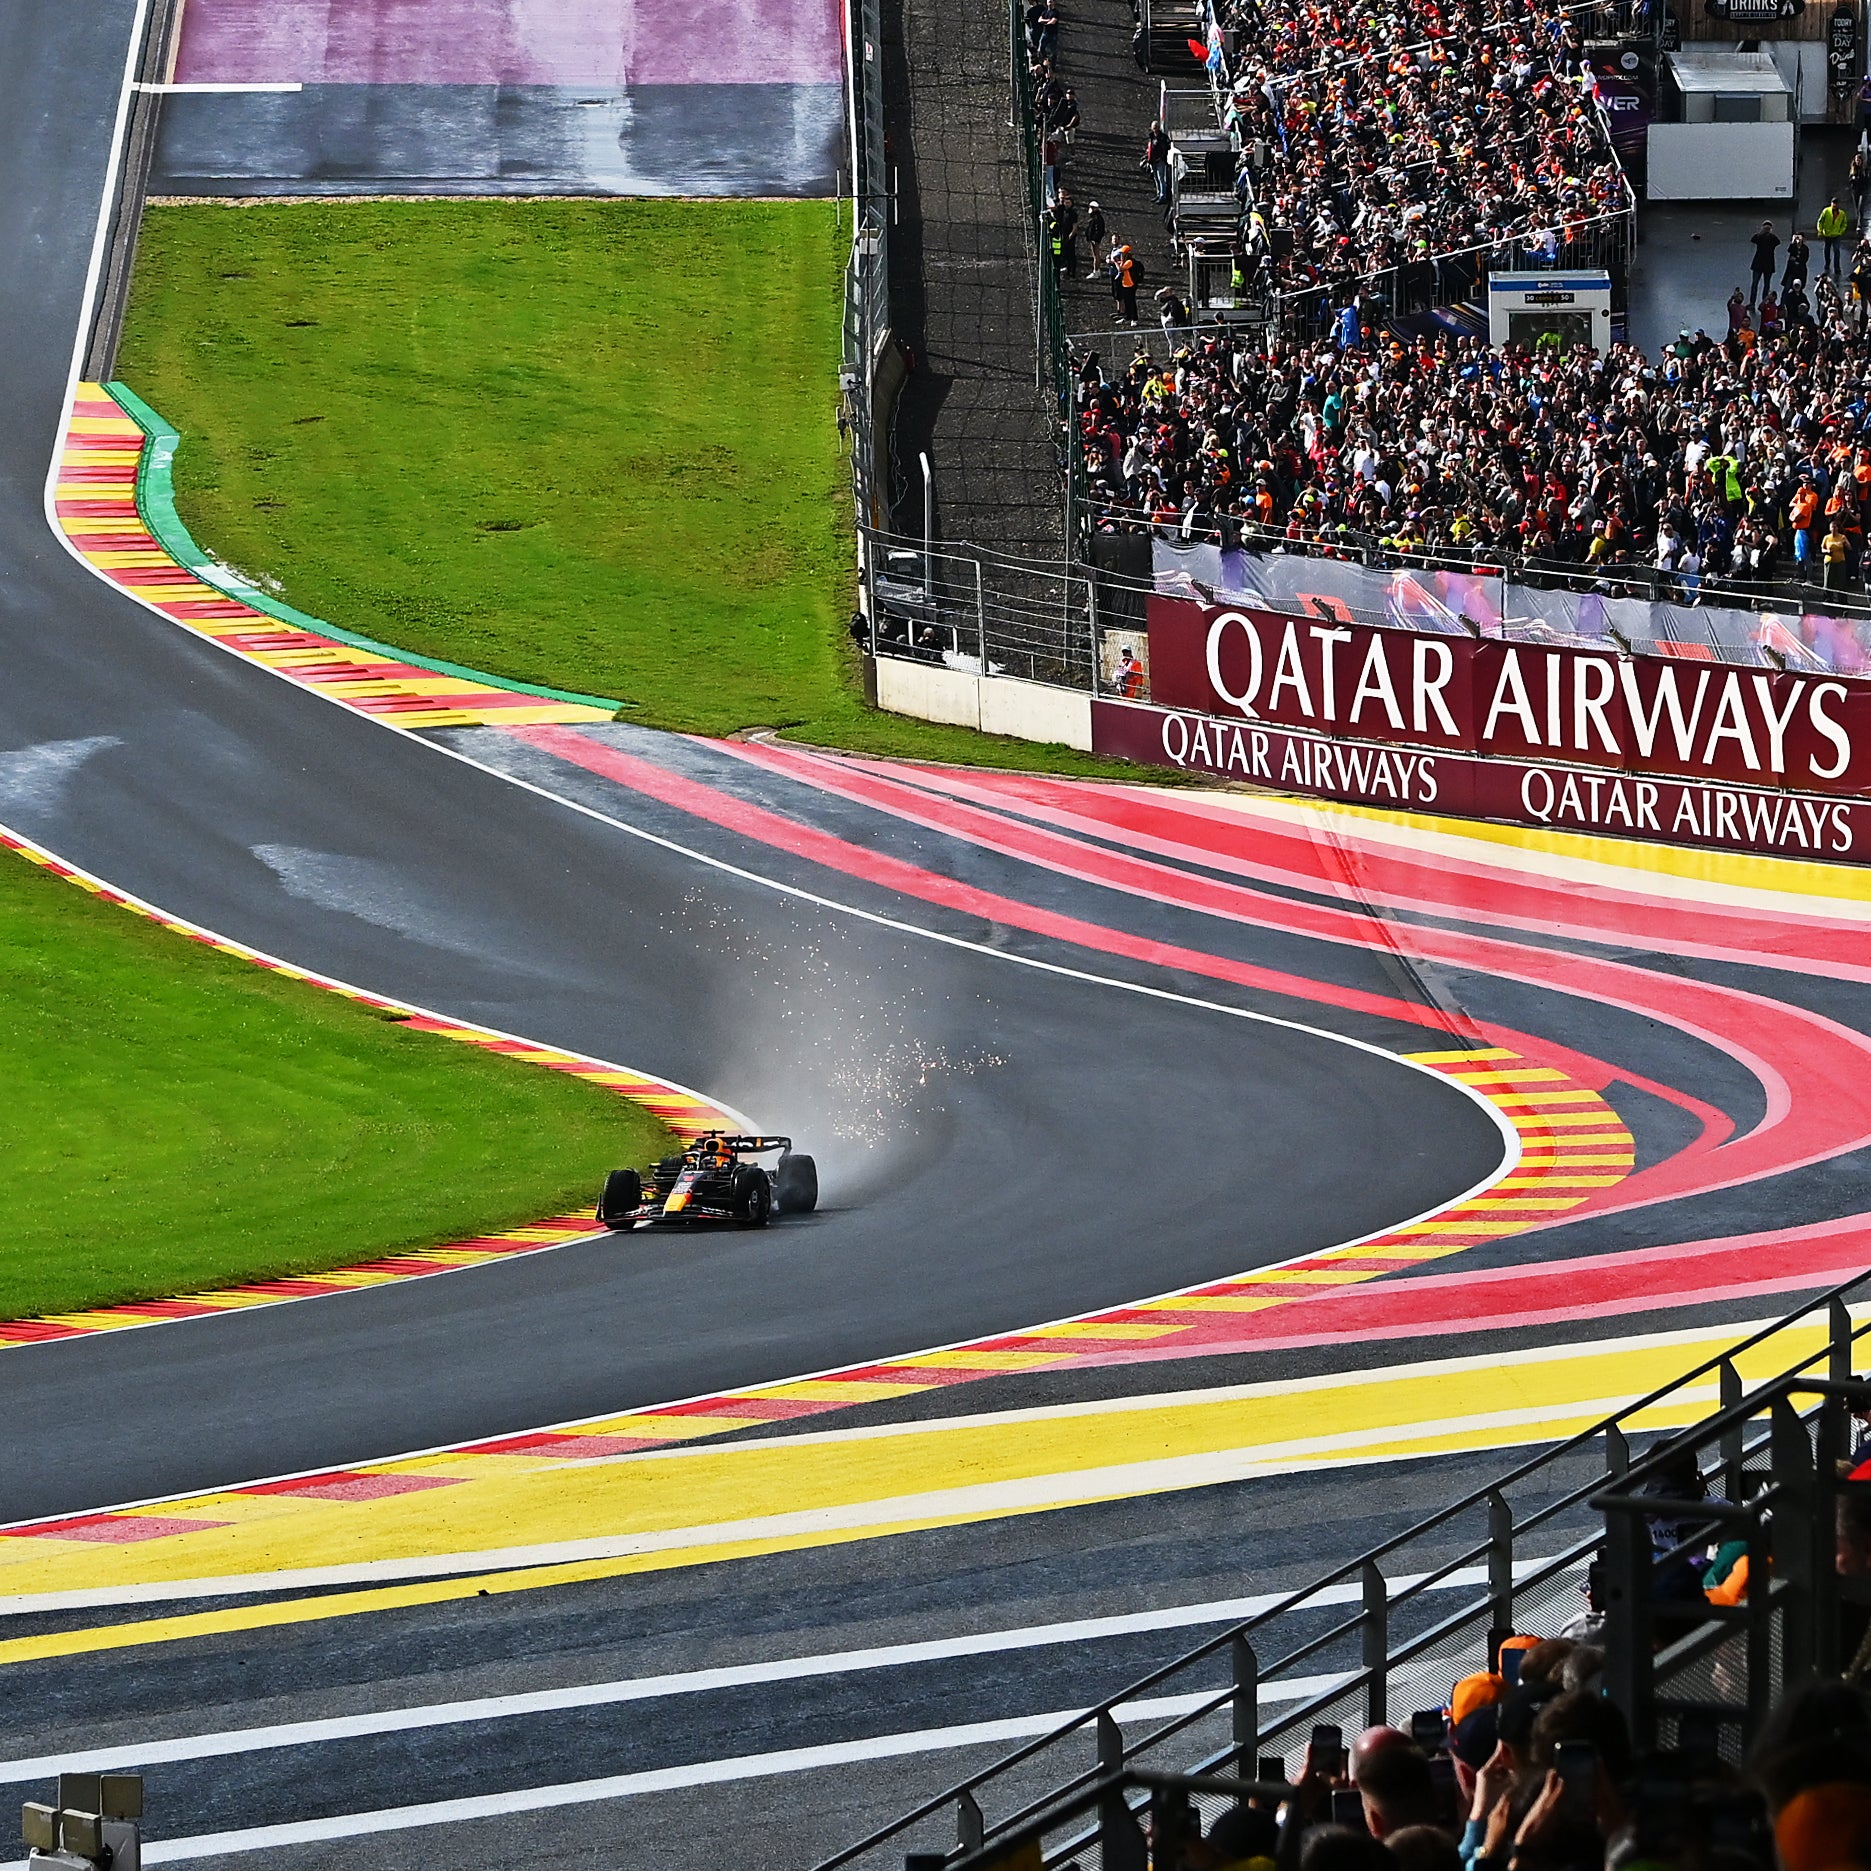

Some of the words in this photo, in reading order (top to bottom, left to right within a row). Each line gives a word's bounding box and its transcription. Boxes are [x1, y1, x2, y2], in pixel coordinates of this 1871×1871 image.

[1834, 38, 1852, 48] DAY
[1205, 612, 1461, 738] QATAR
[1483, 647, 1854, 780] AIRWAYS
[1161, 714, 1271, 780] QATAR
[1281, 735, 1439, 805] AIRWAYS
[1522, 768, 1660, 833] QATAR
[1671, 787, 1854, 853] AIRWAYS
